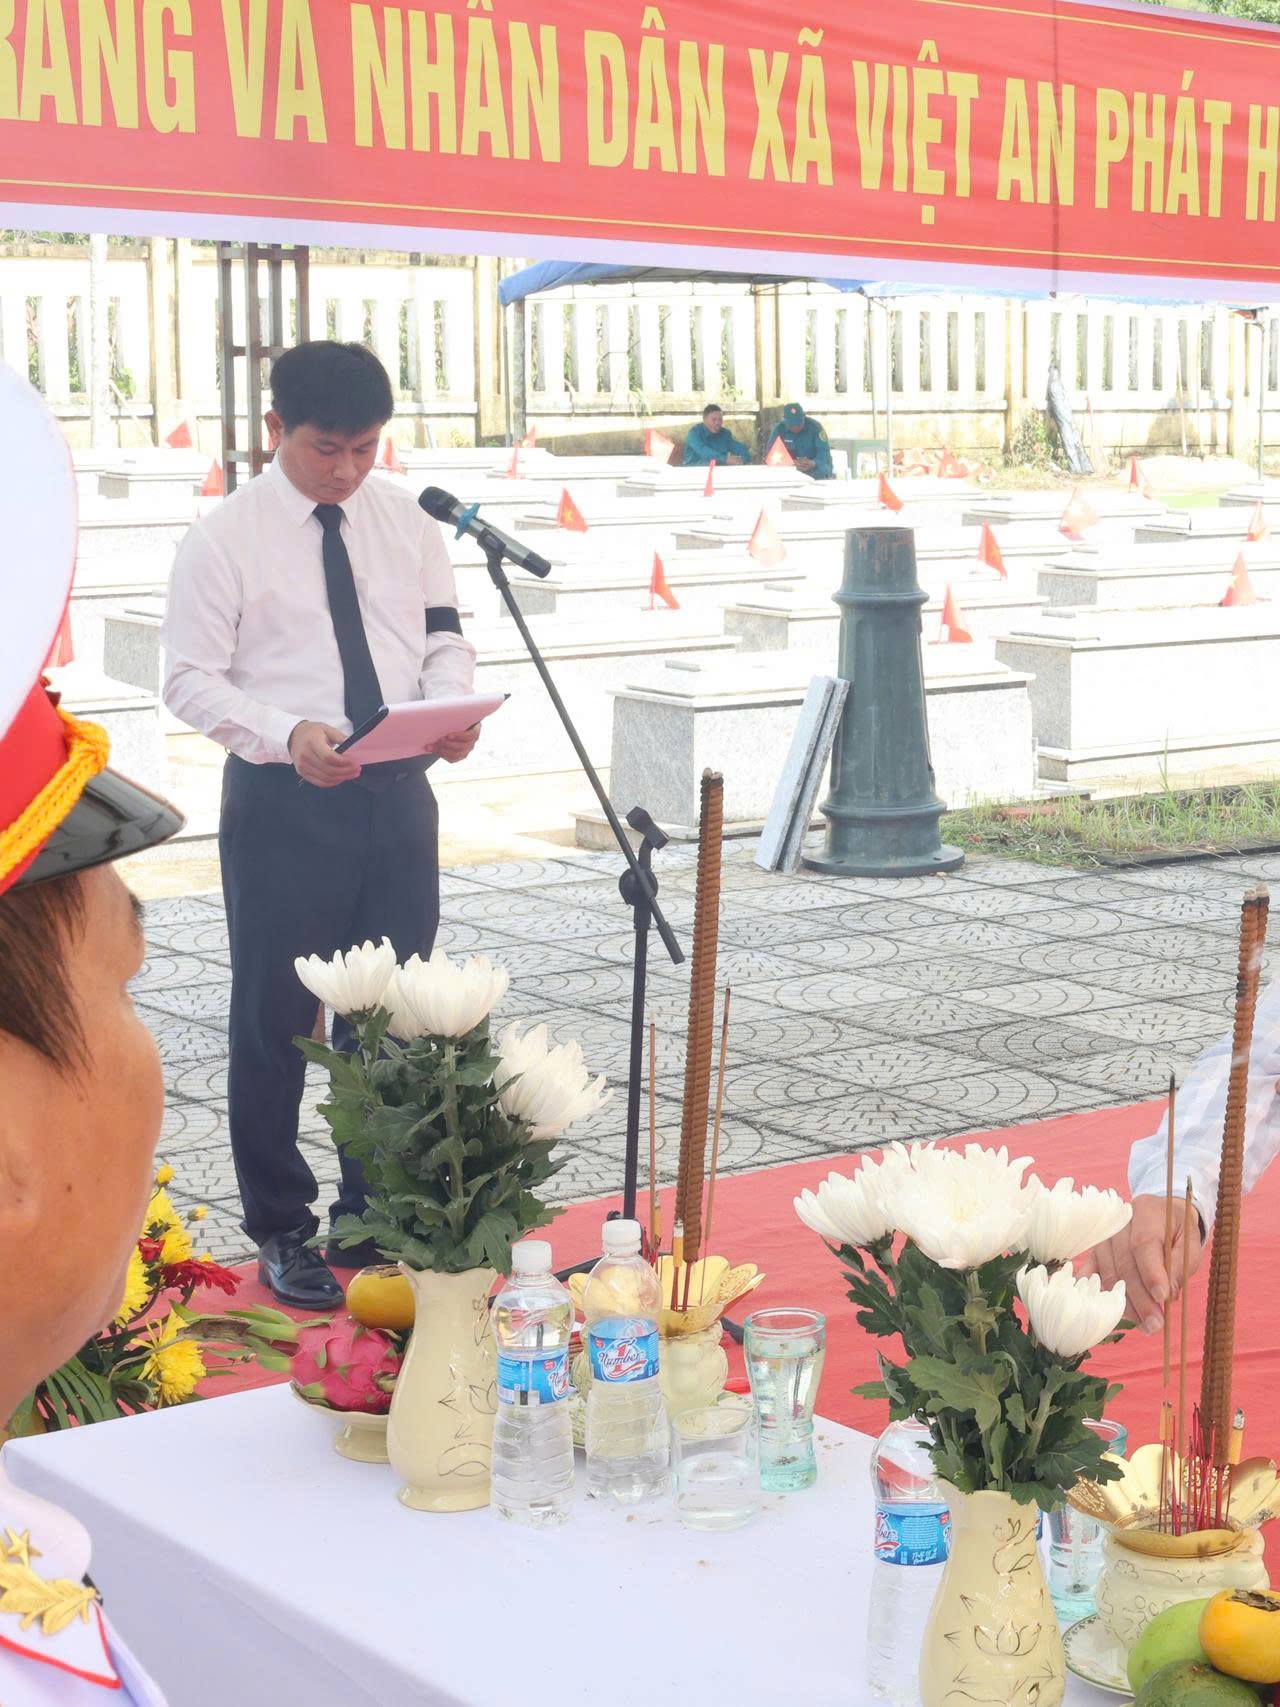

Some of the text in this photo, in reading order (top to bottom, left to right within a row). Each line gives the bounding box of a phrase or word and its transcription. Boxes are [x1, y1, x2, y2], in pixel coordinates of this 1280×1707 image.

[351, 0, 560, 162] NHÂN
[585, 7, 724, 176] DÂN
[749, 28, 833, 185] XÃ
[853, 40, 978, 224] VIỆT
[997, 78, 1075, 205] AN
[1096, 71, 1231, 217] PHÁT
[598, 1350, 641, 1368] Number
